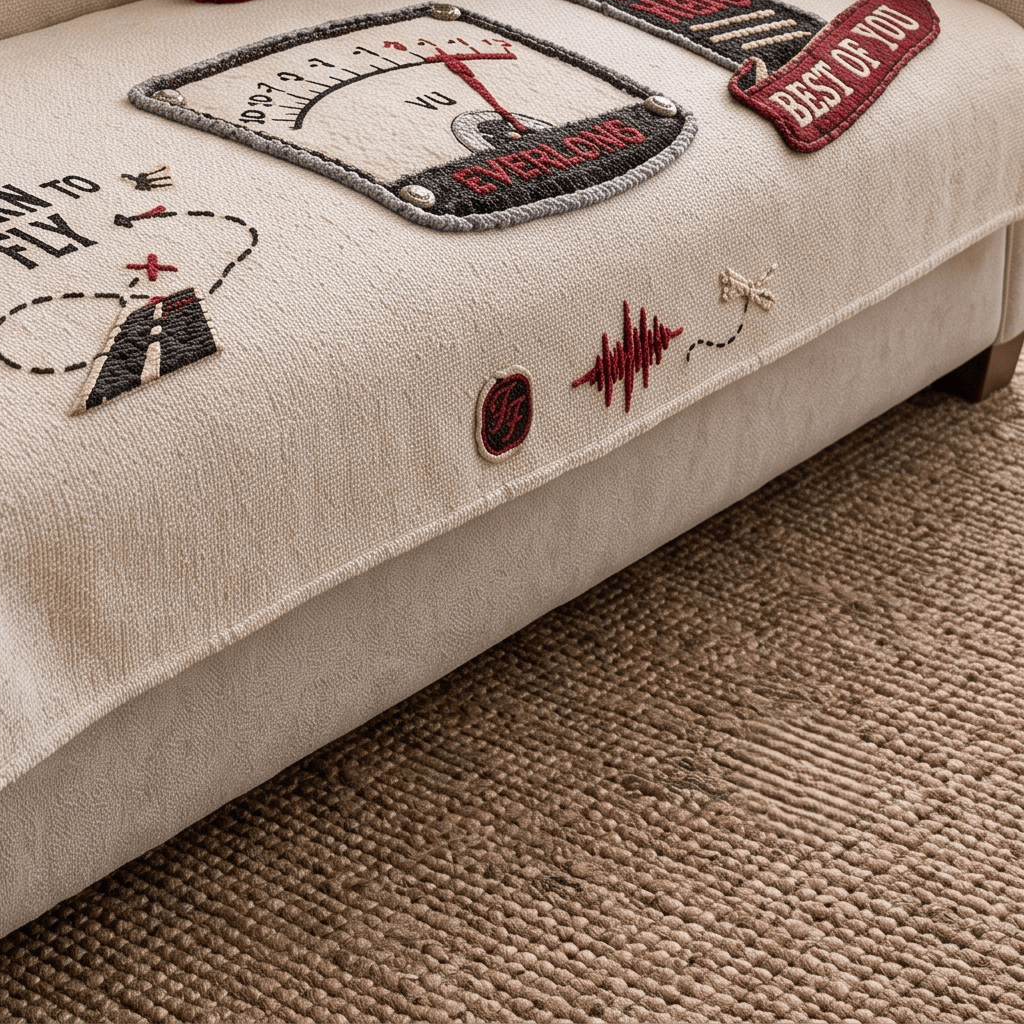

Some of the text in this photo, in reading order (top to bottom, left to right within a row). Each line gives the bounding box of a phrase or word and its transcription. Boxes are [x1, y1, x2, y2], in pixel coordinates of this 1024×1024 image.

[769, 4, 919, 127] BEST OF YOU
[404, 91, 457, 111] VU
[451, 119, 646, 194] EVERLONG
[39, 175, 100, 199] TO
